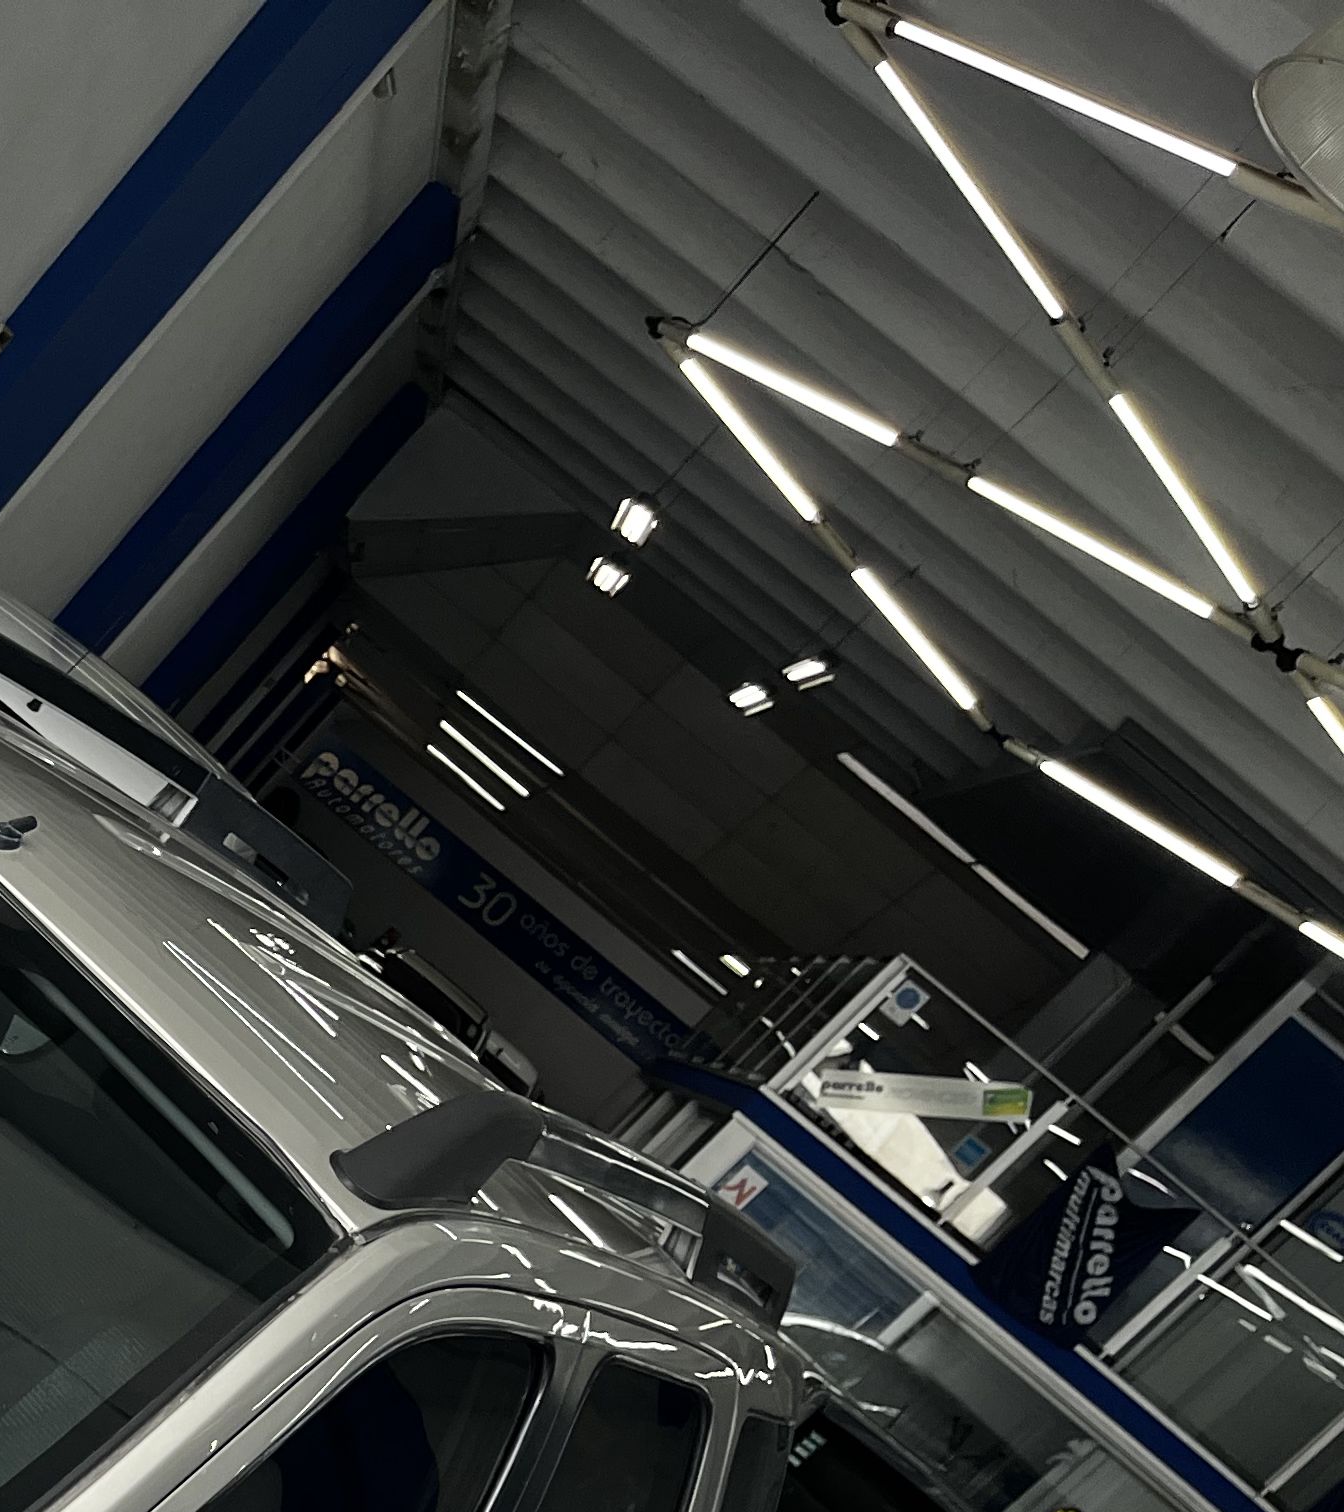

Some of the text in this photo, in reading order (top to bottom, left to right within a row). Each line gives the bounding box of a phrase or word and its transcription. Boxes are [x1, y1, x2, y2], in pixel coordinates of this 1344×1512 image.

[300, 751, 441, 861] parrello
[458, 872, 517, 926] 30
[520, 913, 570, 956] años
[570, 955, 599, 981] de
[1039, 1169, 1093, 1326] multimarcas
[1073, 1165, 1124, 1327] parrello
